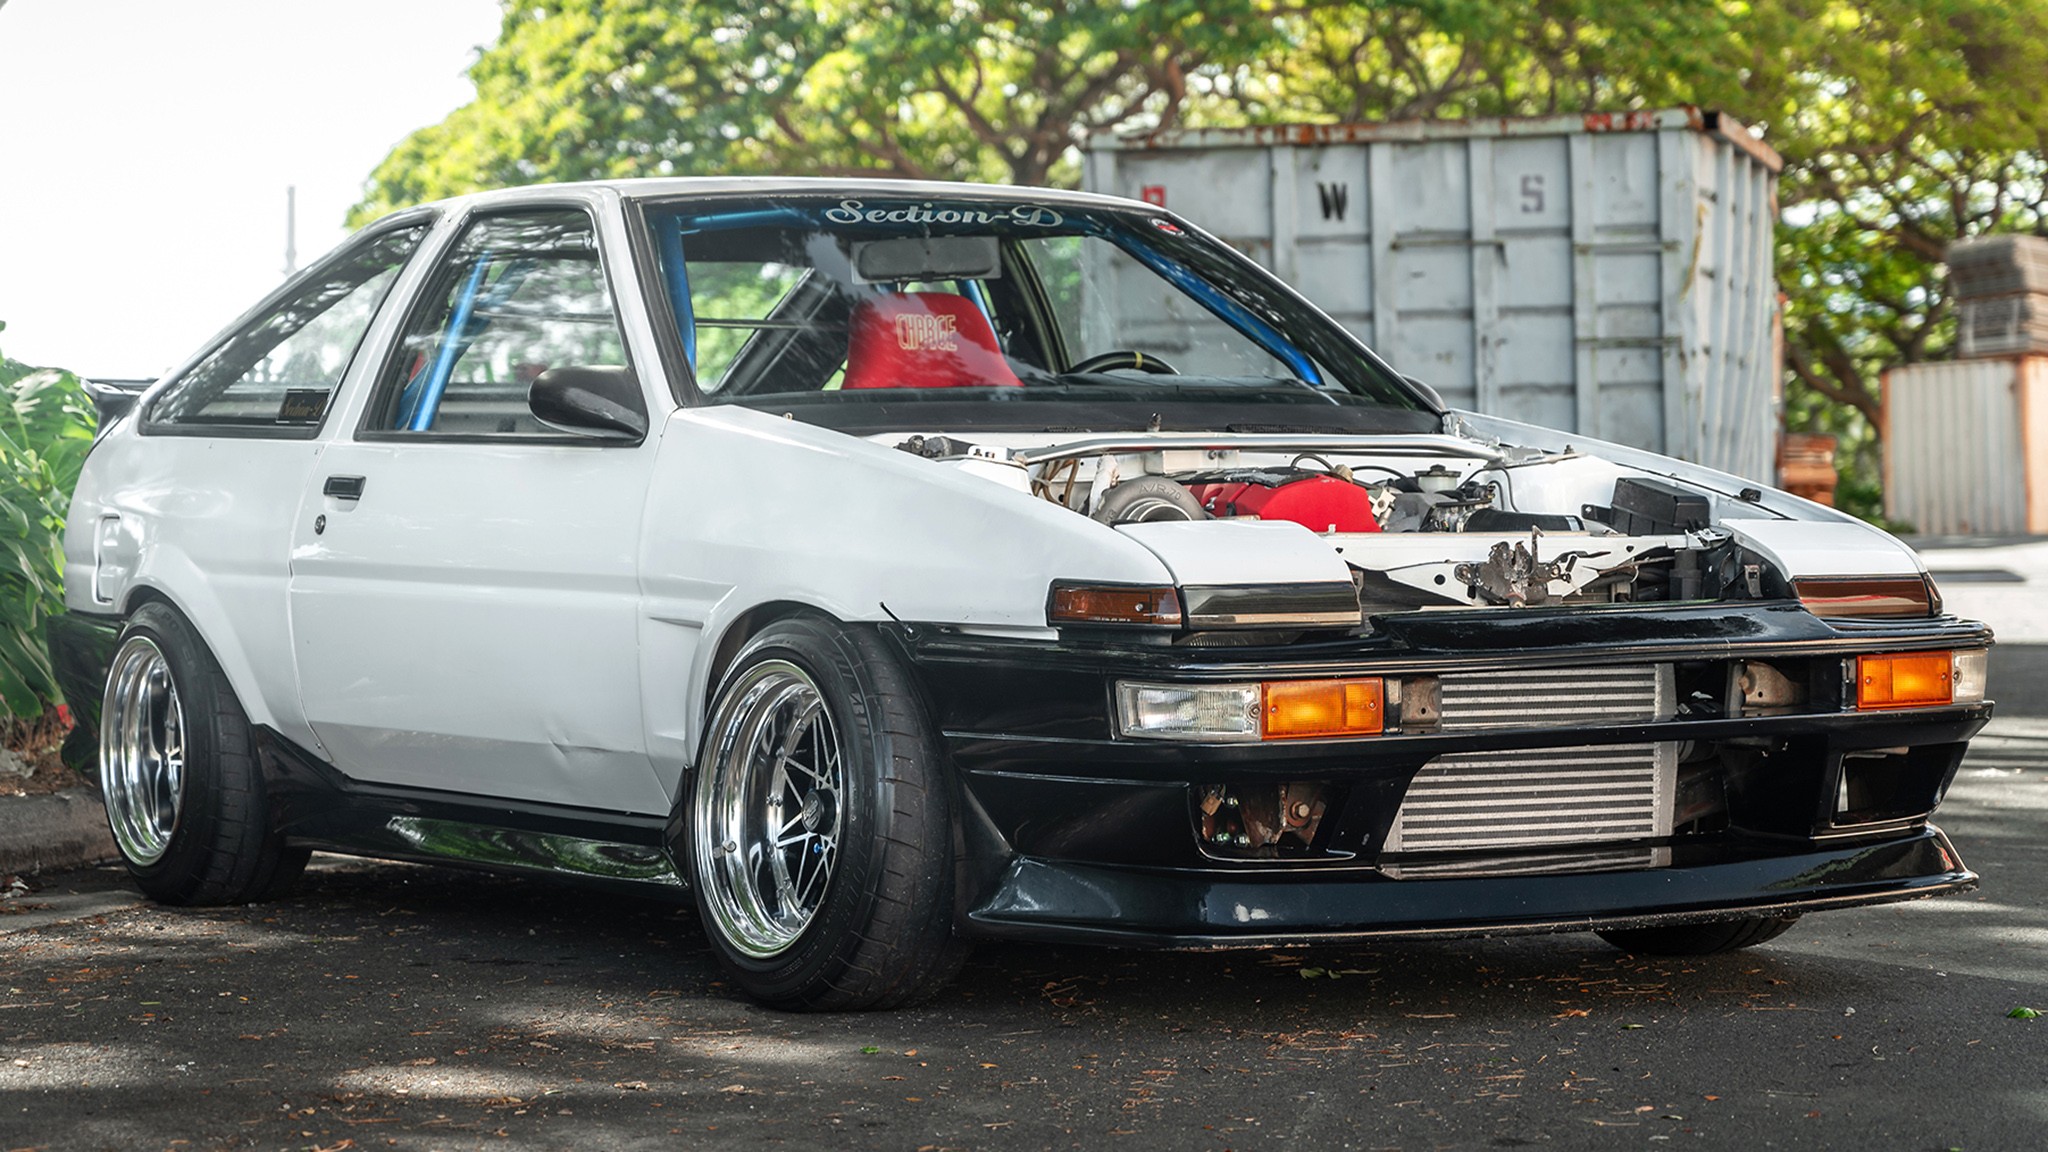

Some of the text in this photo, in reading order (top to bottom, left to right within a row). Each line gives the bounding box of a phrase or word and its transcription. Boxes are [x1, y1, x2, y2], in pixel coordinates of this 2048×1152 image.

[825, 199, 1064, 228] Section-D
[1317, 174, 1545, 220] W S
